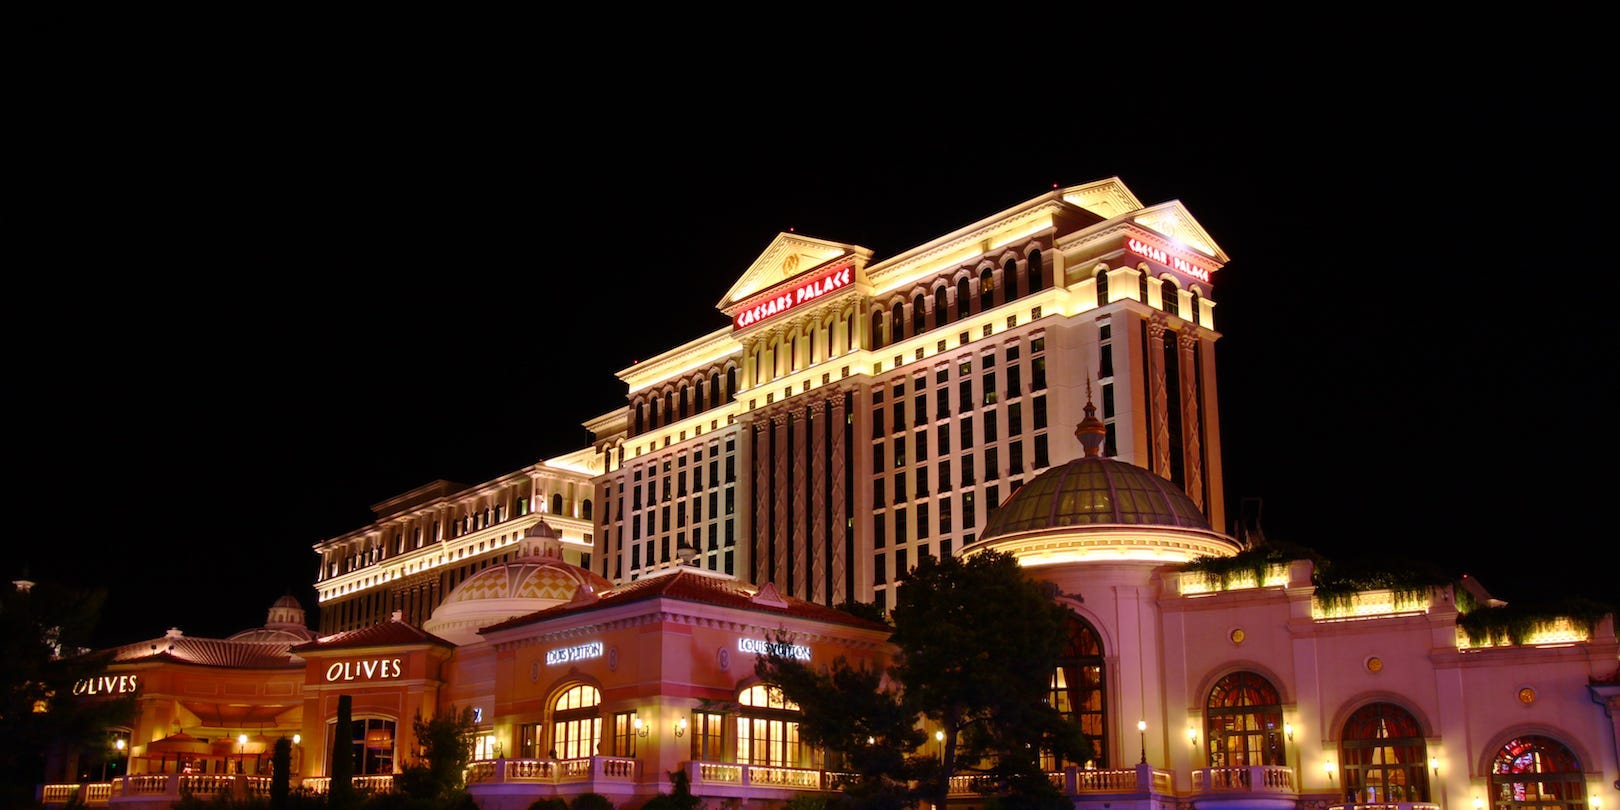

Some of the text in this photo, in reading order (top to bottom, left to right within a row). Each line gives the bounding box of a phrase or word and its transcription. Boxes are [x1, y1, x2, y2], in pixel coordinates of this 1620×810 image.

[1173, 256, 1209, 283] PALACE
[737, 267, 850, 328] CAESARS PALACE
[546, 641, 604, 665] LOUIS VUITTON
[738, 638, 769, 655] LOUIS
